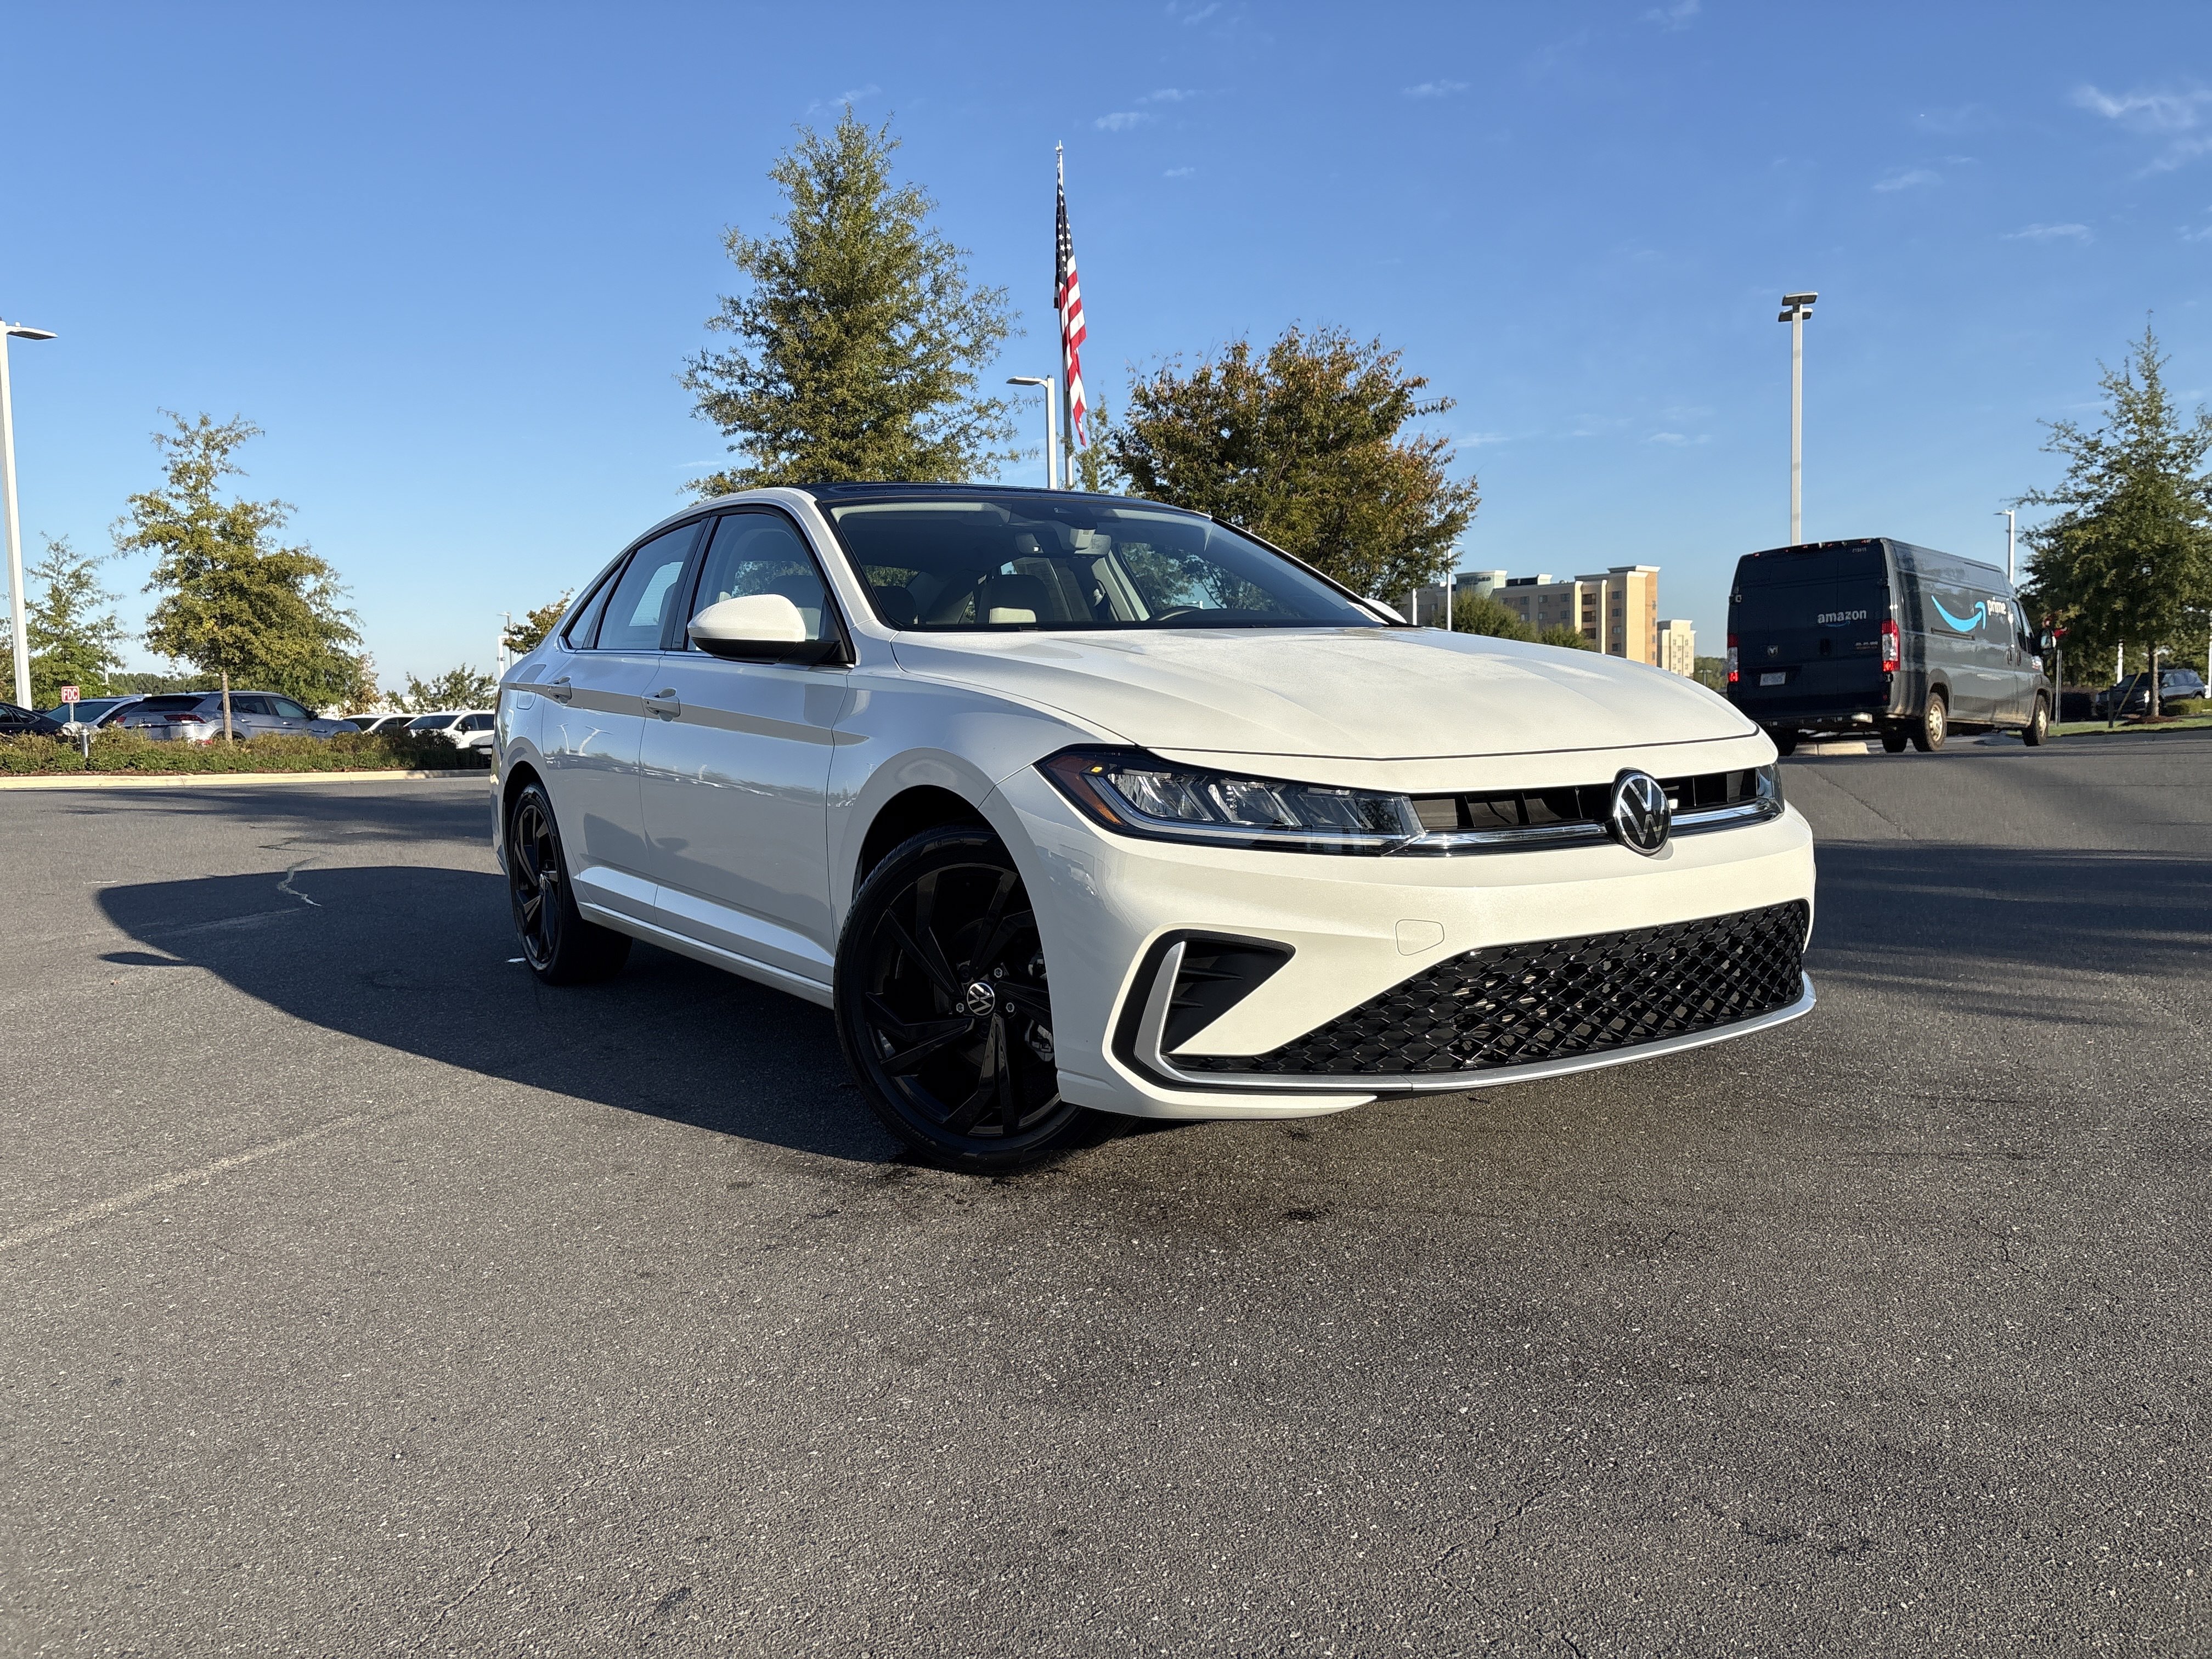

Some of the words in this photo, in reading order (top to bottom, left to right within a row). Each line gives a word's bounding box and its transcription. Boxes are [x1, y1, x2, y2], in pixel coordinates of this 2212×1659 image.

[1987, 600, 2006, 616] prime
[1818, 610, 1867, 624] amazon
[63, 688, 78, 700] FDC
